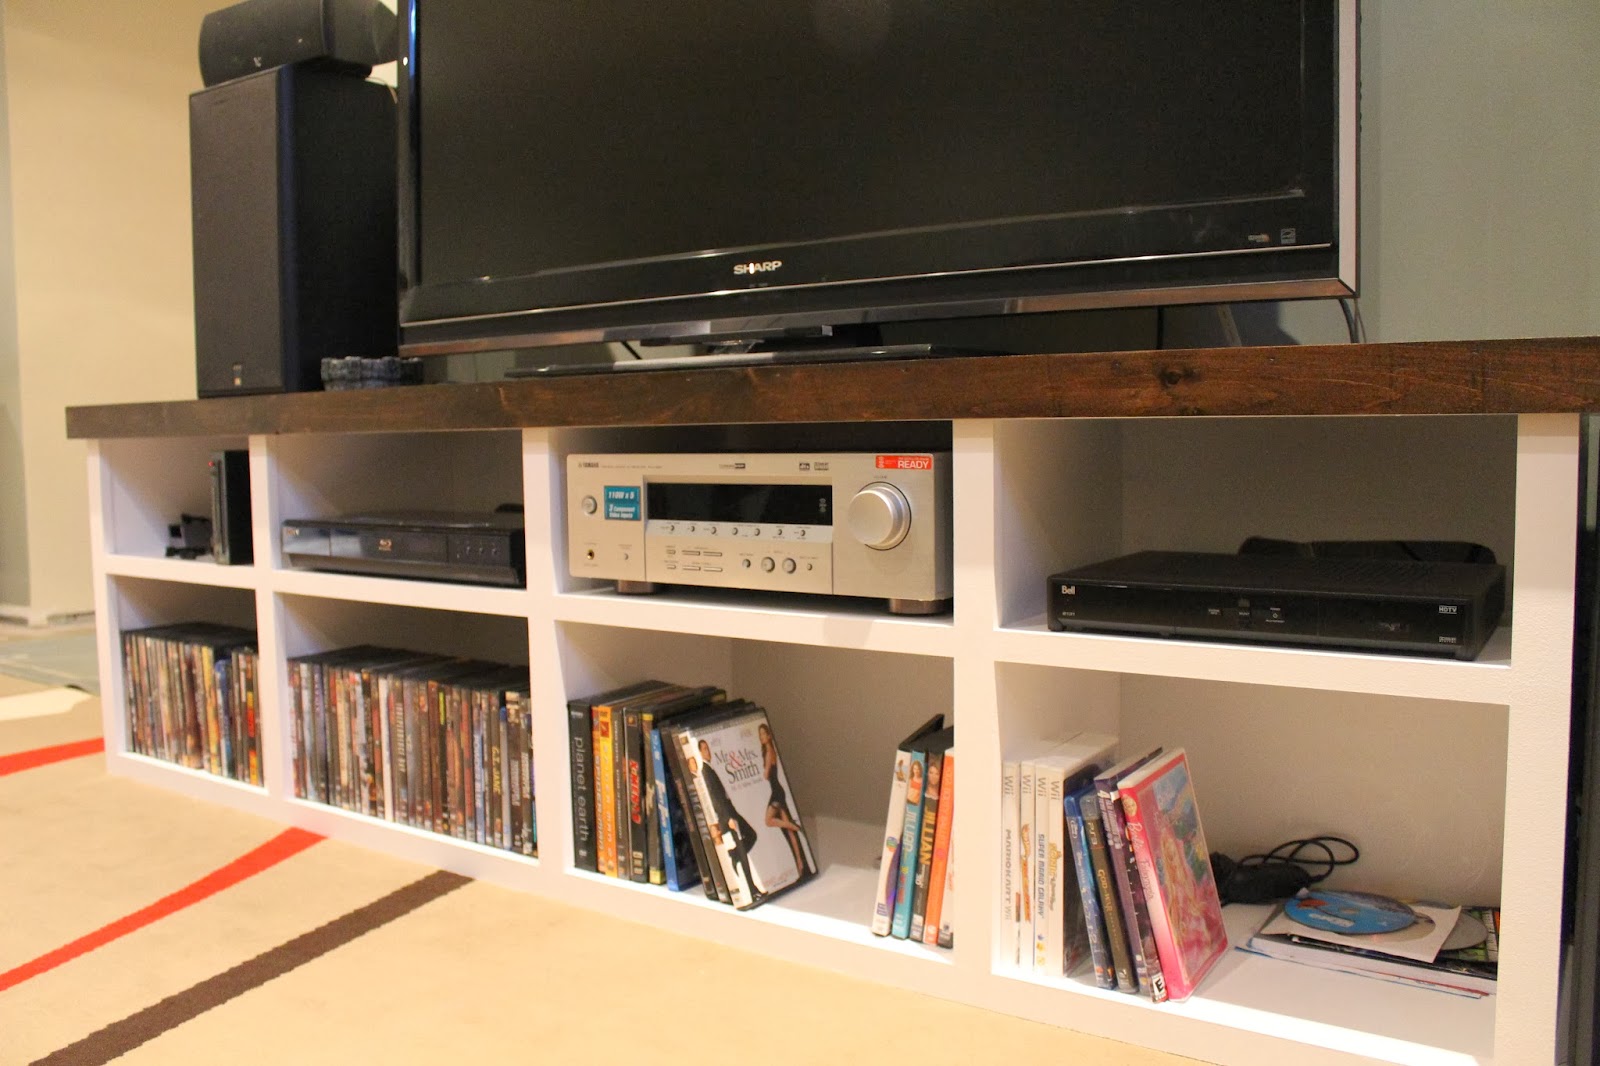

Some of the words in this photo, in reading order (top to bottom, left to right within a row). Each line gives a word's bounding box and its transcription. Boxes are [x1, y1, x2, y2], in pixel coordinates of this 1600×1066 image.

[733, 260, 782, 275] SHARP
[897, 460, 929, 469] READY
[1061, 585, 1076, 595] Bell
[1439, 605, 1457, 614] HDTV
[574, 736, 587, 790] planet
[725, 760, 760, 784] Smith
[1004, 775, 1013, 795] Wii
[1022, 774, 1031, 794] Wii
[1038, 777, 1046, 797] Wii
[1051, 780, 1060, 800] Wii
[577, 796, 589, 841] earth
[919, 802, 936, 865] JILLIAN
[1088, 822, 1098, 845] PS3
[1097, 869, 1108, 891] GOD
[1037, 887, 1045, 916] GALAXY
[1004, 905, 1012, 920] Wii
[1154, 979, 1165, 993] E
